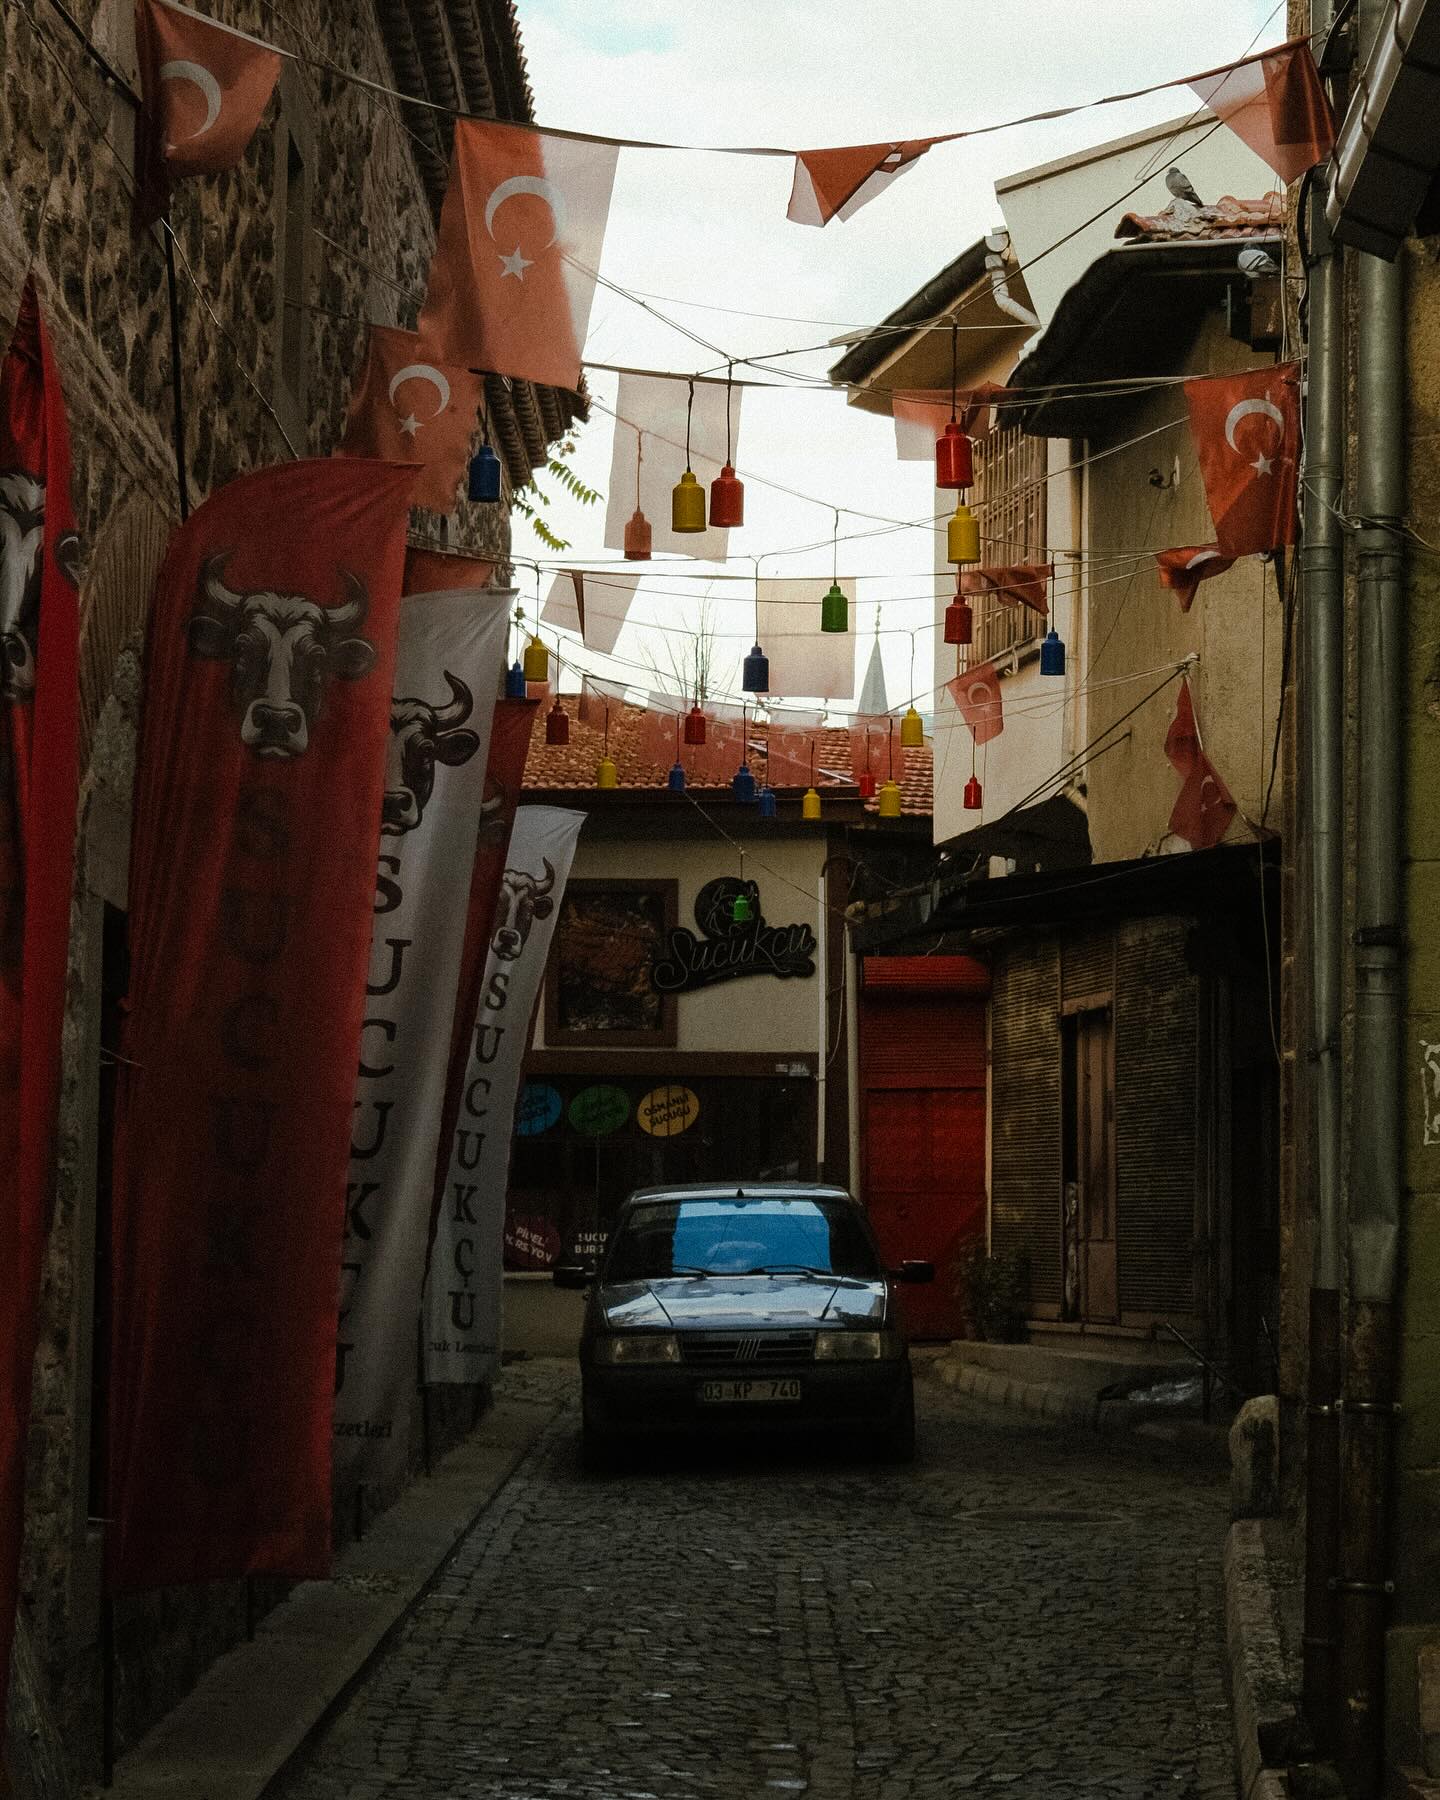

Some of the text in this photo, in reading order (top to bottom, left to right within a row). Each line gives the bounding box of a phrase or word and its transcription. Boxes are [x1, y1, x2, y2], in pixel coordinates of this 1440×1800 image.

[447, 973, 508, 1331] SUCUKÇU
[578, 1232, 609, 1242] SUCU
[704, 1383, 723, 1400] 03
[734, 1382, 753, 1399] KP
[334, 1421, 392, 1439] zetleri
